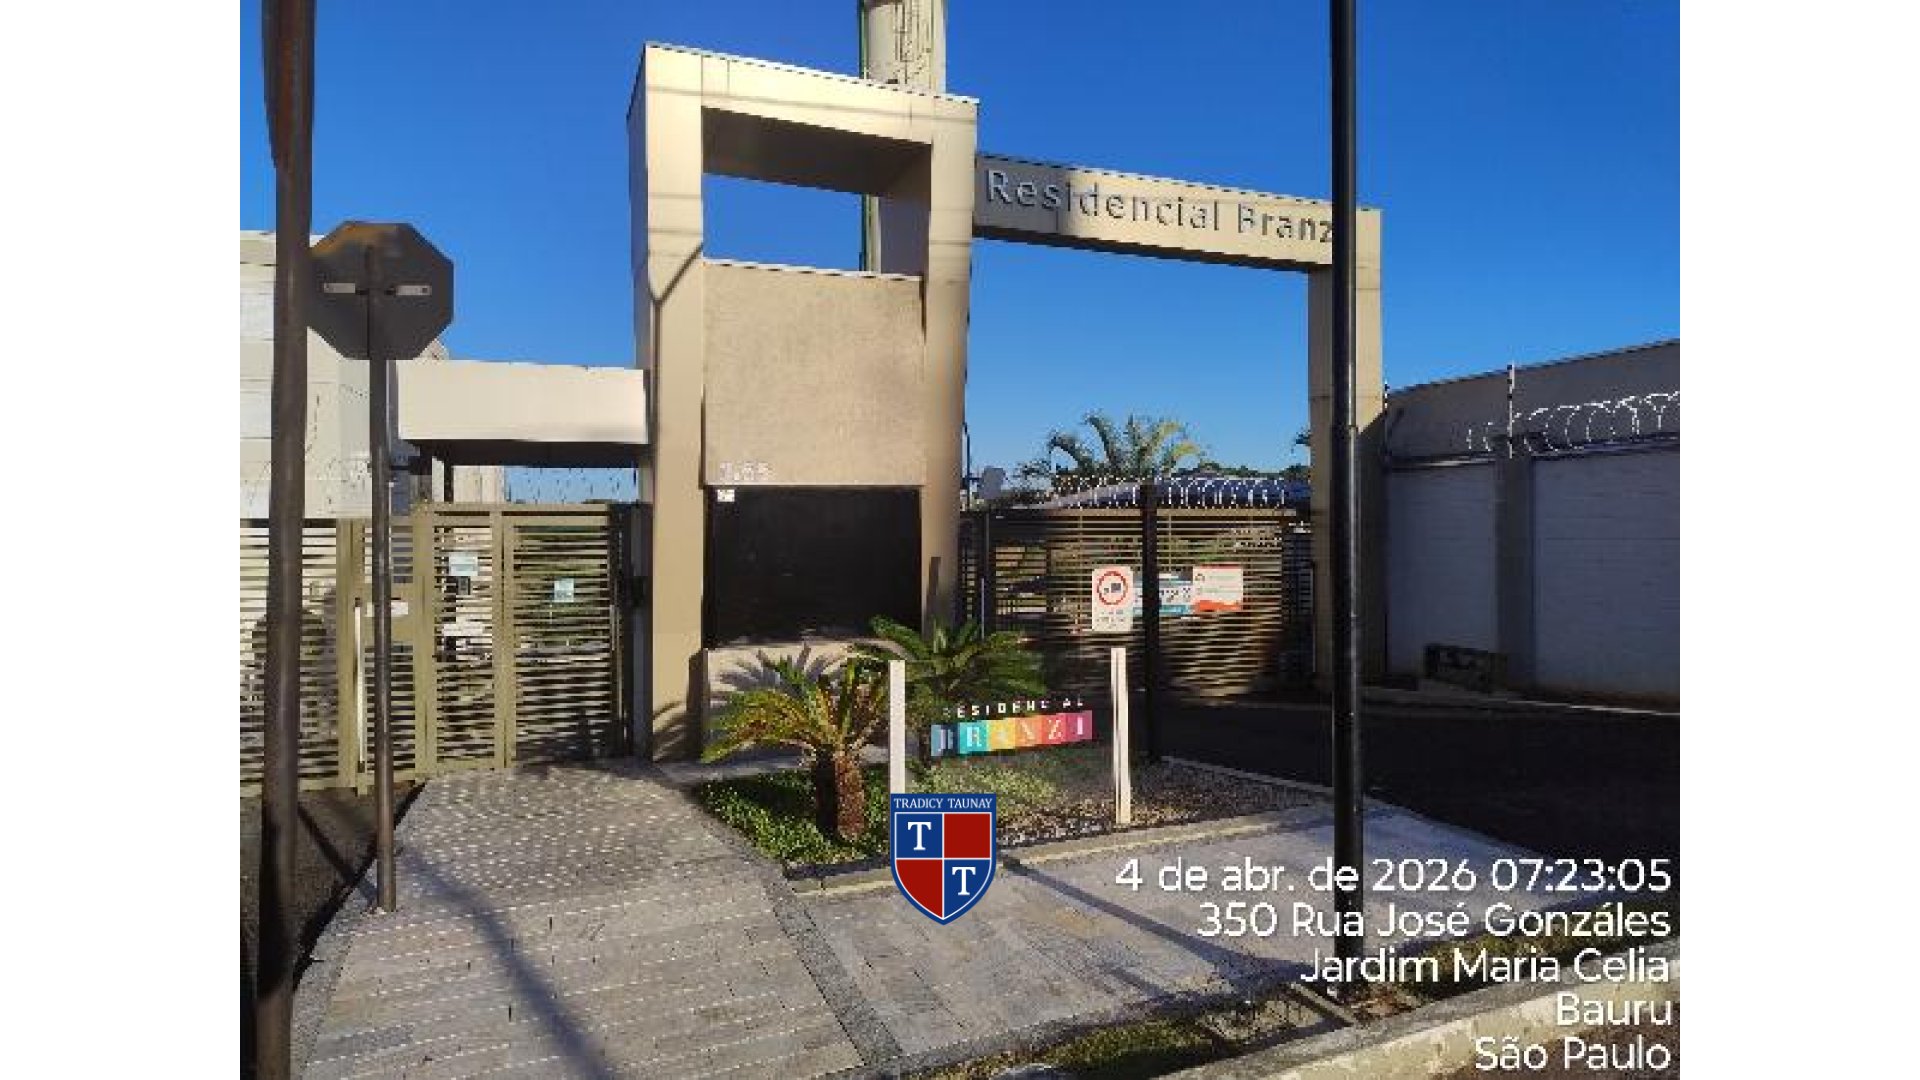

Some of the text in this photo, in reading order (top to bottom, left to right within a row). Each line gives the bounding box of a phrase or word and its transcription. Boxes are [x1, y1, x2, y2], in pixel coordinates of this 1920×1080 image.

[986, 168, 1333, 243] Residencial Branz
[943, 696, 1084, 719] ESIDENCAL
[938, 715, 1084, 752] BRNZI
